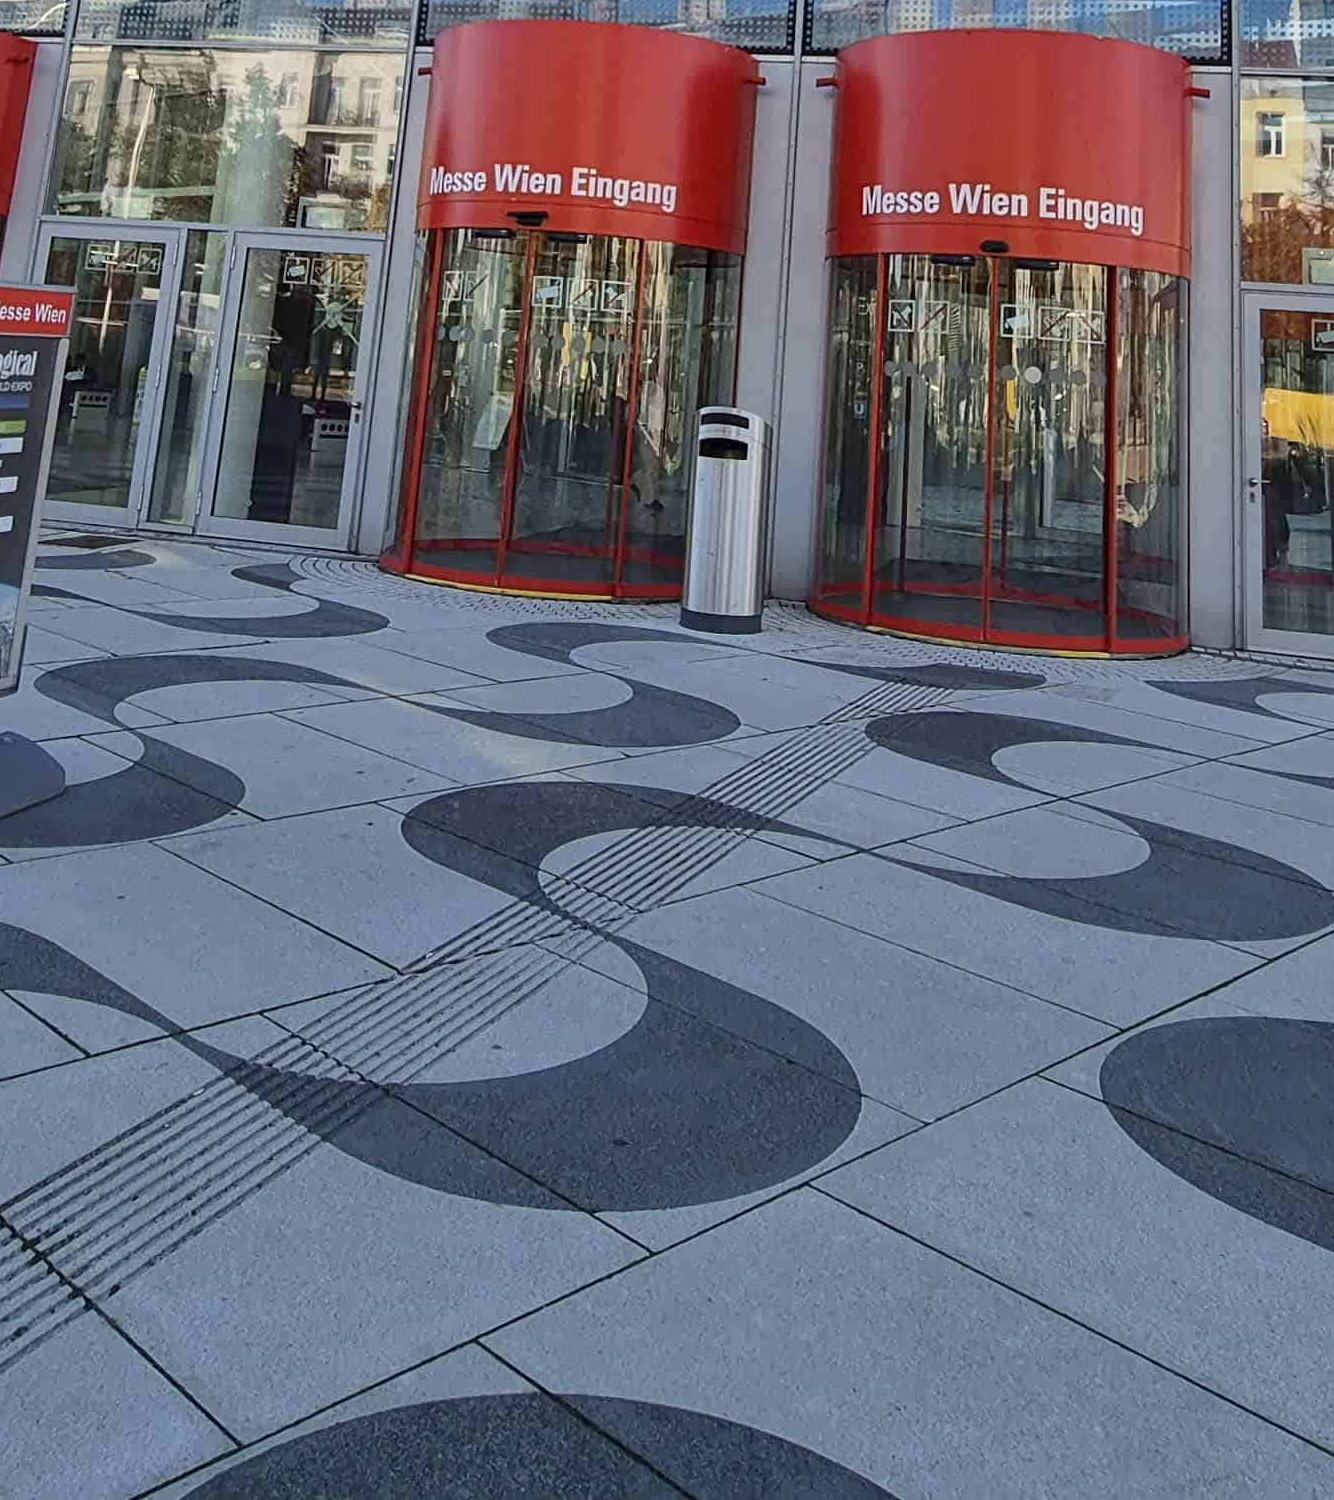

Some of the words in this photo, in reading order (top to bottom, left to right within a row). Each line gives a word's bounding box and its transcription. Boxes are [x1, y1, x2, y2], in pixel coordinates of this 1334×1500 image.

[430, 165, 487, 195] Messe
[494, 163, 563, 195] Wien
[570, 166, 678, 213] Eingang
[861, 185, 939, 218] Messe
[948, 183, 1028, 218] Wien
[1038, 186, 1145, 236] Eingang
[35, 302, 67, 324] Wien
